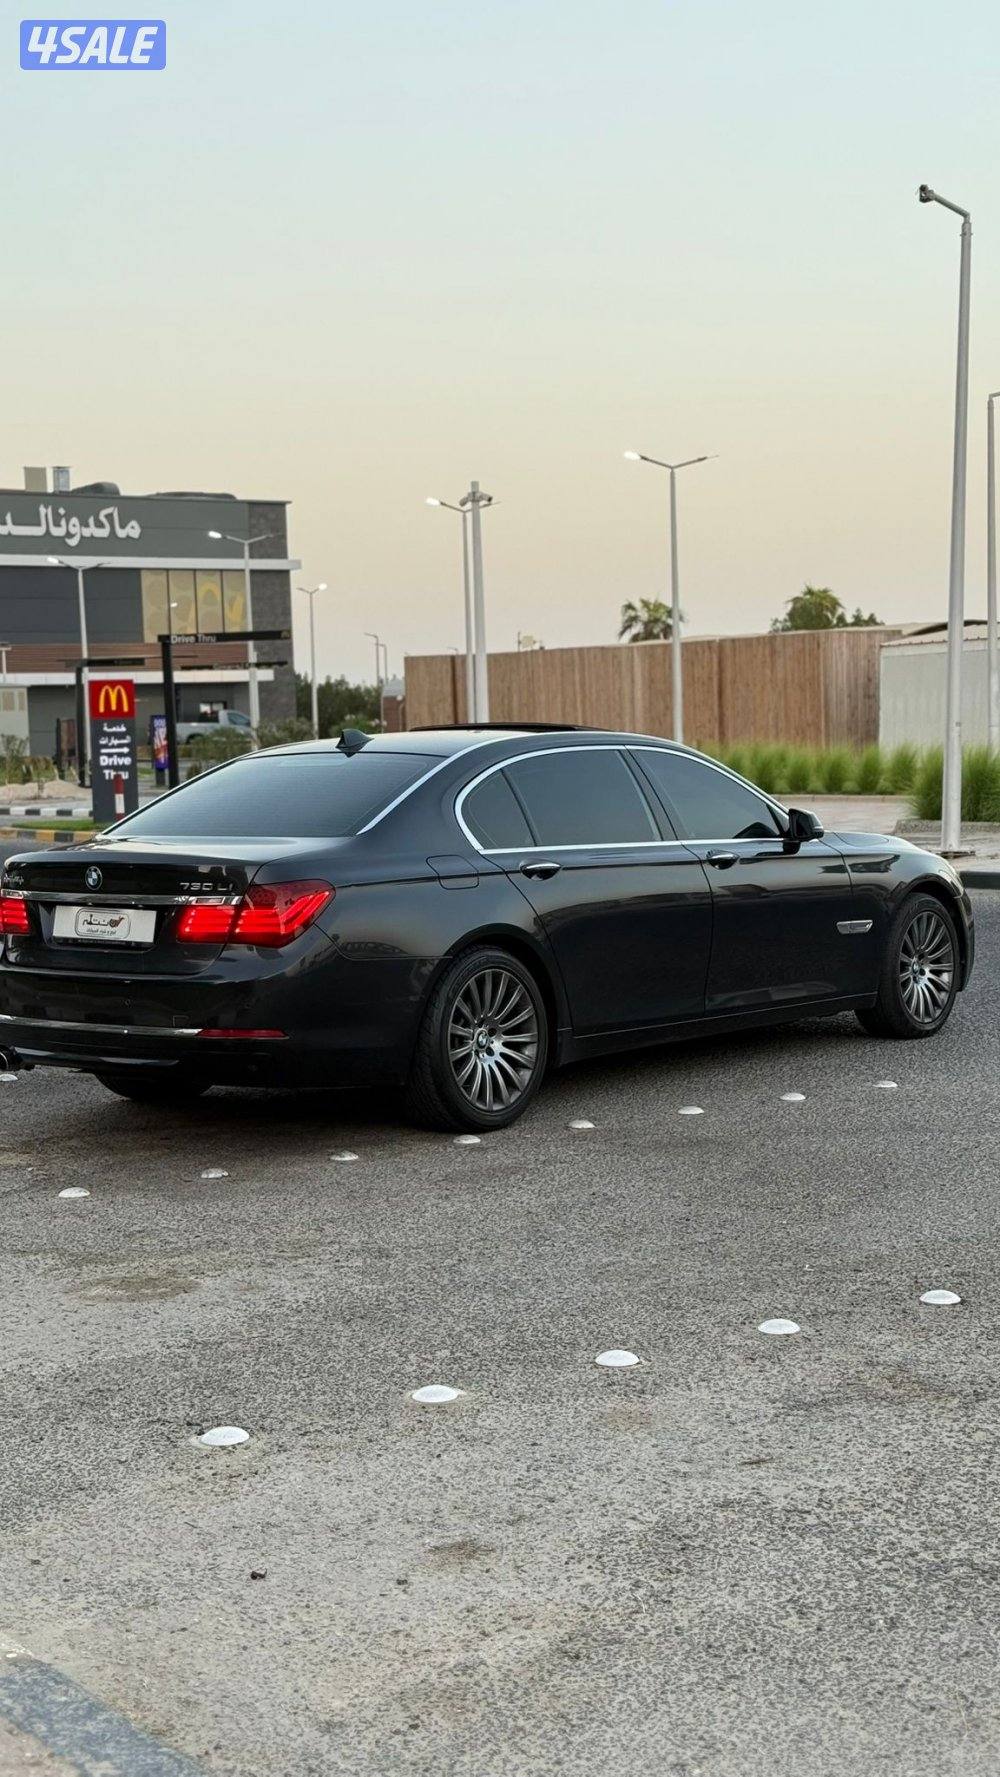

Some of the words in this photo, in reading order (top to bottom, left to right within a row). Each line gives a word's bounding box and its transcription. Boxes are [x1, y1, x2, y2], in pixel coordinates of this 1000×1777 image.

[171, 634, 195, 644] Drive
[197, 634, 217, 643] Thru
[99, 755, 132, 766] Drive
